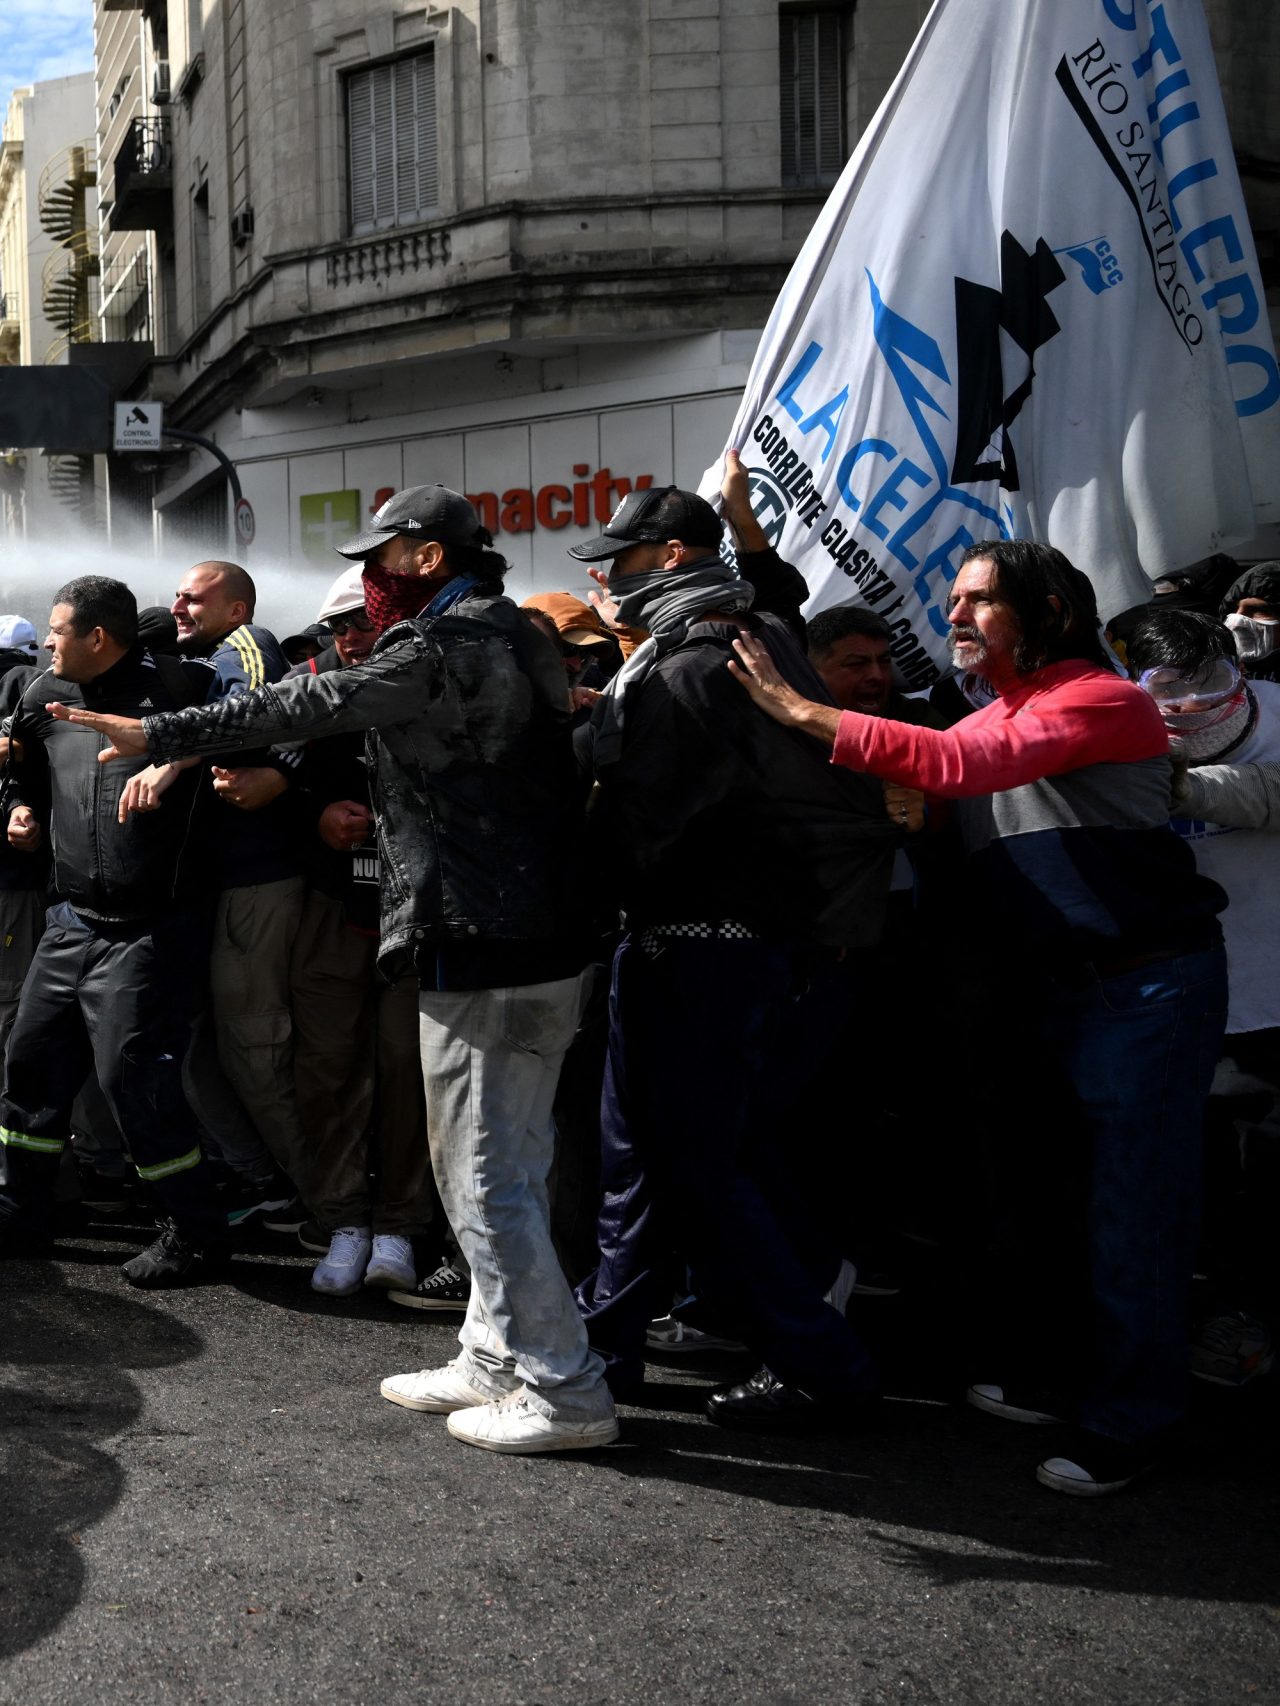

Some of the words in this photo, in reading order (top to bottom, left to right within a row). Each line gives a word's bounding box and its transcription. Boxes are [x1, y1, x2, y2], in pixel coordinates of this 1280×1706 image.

[1072, 38, 1128, 114] RÍO
[1115, 121, 1202, 346] SANTIAGO
[1095, 240, 1123, 287] CCC
[775, 341, 849, 464] LA
[239, 511, 252, 532] 10
[753, 414, 828, 530] CORRIENTE
